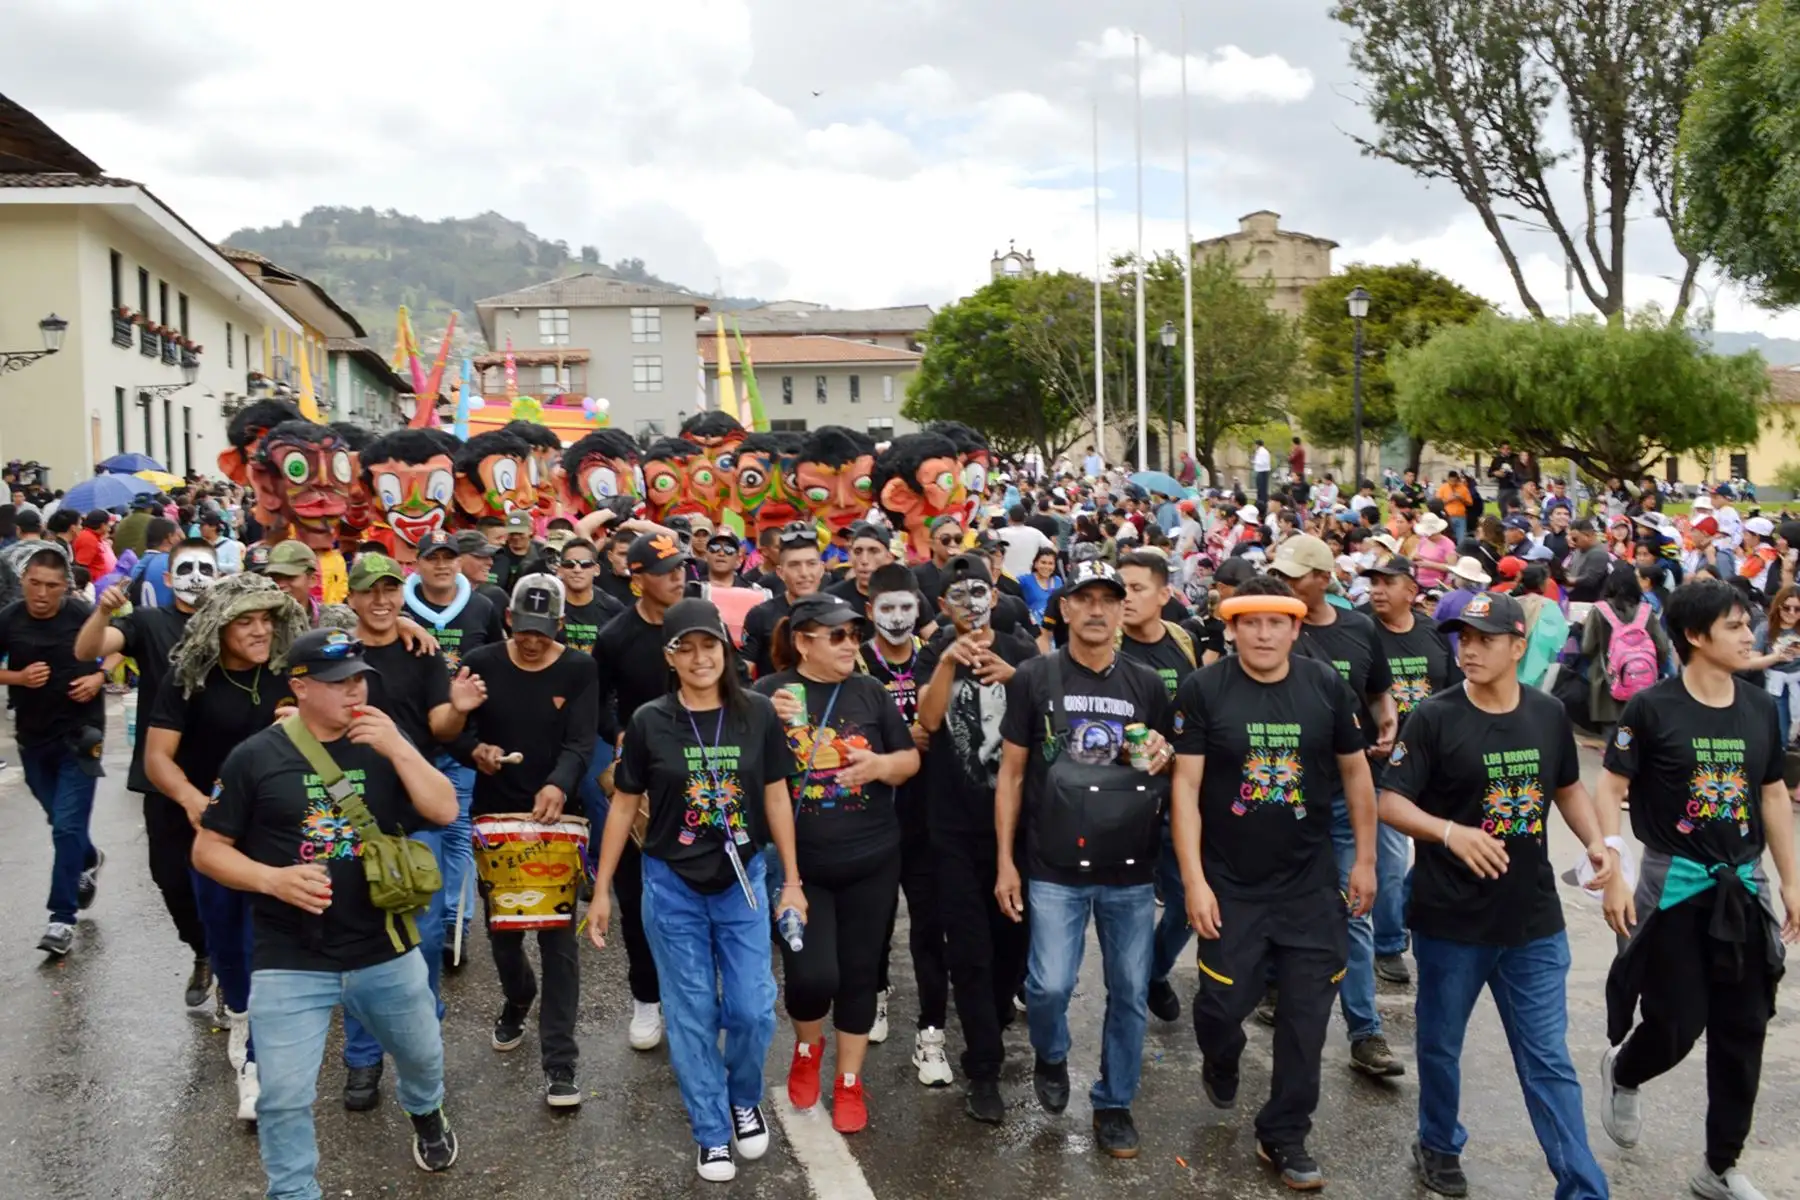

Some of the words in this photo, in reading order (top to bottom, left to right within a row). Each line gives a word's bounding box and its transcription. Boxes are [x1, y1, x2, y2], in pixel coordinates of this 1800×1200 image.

[1246, 722, 1265, 734] LOS
[1266, 723, 1302, 735] BRAVOS
[1250, 735, 1266, 747] DEL
[1267, 736, 1299, 748] ZEPITA
[1692, 738, 1710, 749] LOS
[1712, 738, 1746, 751] BRAVOS
[1483, 753, 1502, 766] LOS
[1503, 748, 1540, 763] BRAVOS
[1696, 750, 1712, 762] DEL
[1714, 751, 1744, 763] ZEPITA
[1488, 766, 1506, 779] DEL
[1507, 763, 1539, 777] ZEPITA
